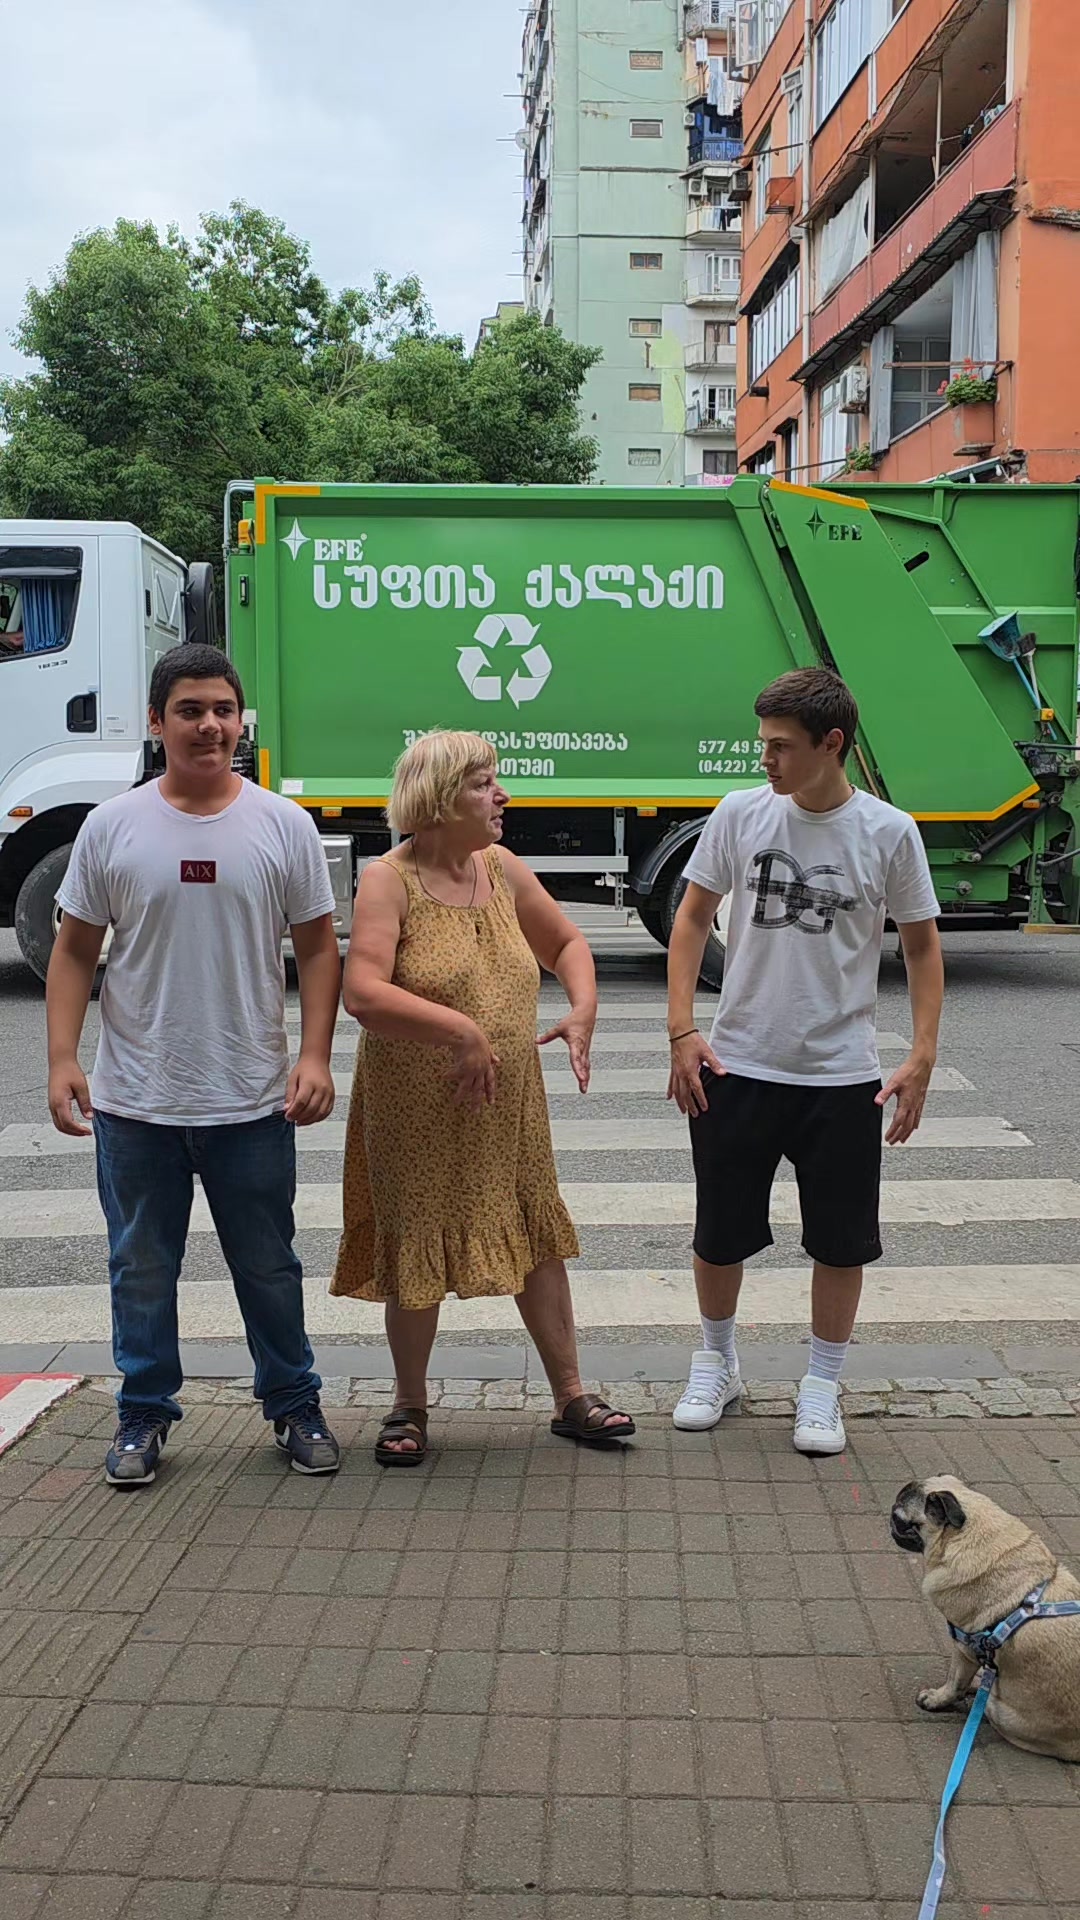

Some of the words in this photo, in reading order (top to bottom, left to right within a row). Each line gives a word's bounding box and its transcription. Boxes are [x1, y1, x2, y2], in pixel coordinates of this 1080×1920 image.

[828, 524, 863, 541] EFE
[313, 564, 496, 609] სუფთა
[525, 564, 724, 609] ქალაქი
[698, 740, 726, 754] 577
[729, 740, 750, 754] 49
[698, 759, 747, 773] (0422)
